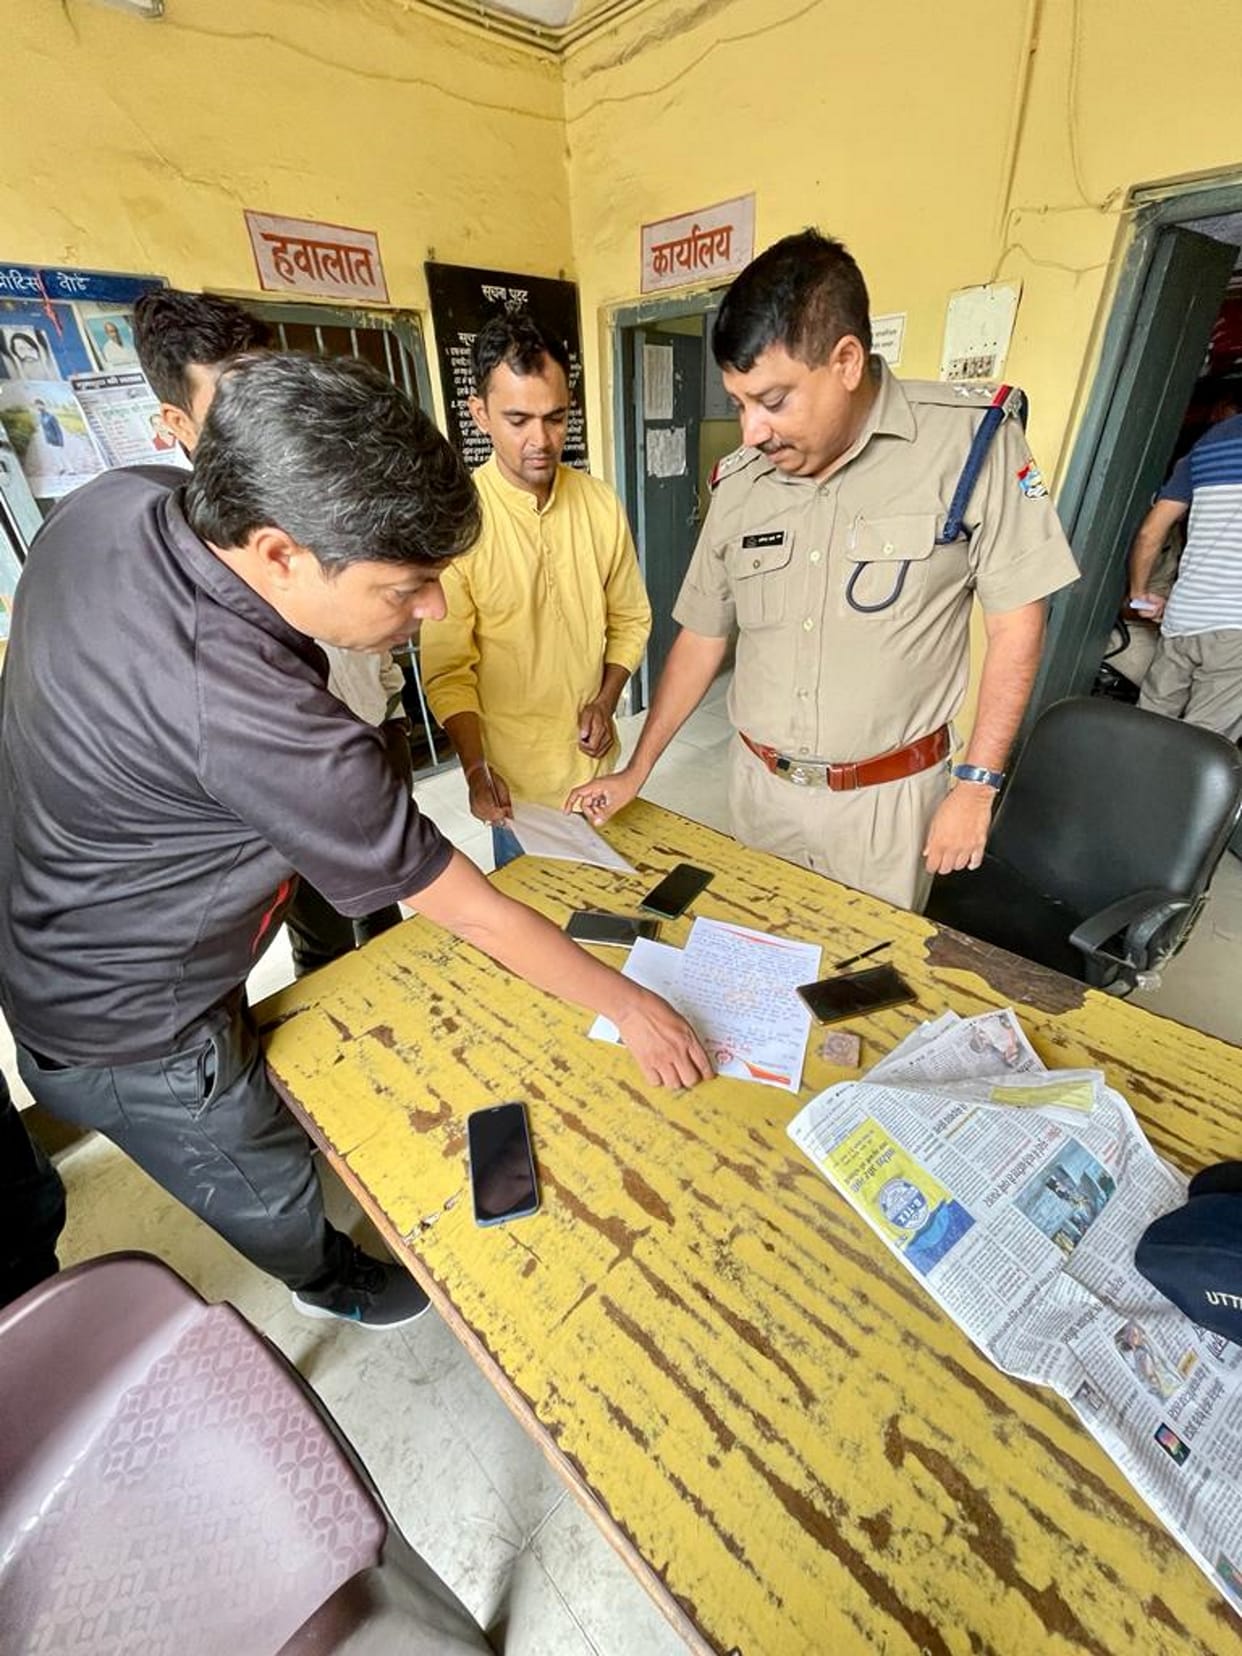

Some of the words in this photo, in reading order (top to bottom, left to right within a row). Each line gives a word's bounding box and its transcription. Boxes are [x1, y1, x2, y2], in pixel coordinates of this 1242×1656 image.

[260, 232, 376, 286] हवालात
[651, 224, 733, 277] कार्यालय
[1205, 1290, 1242, 1309] UTT
